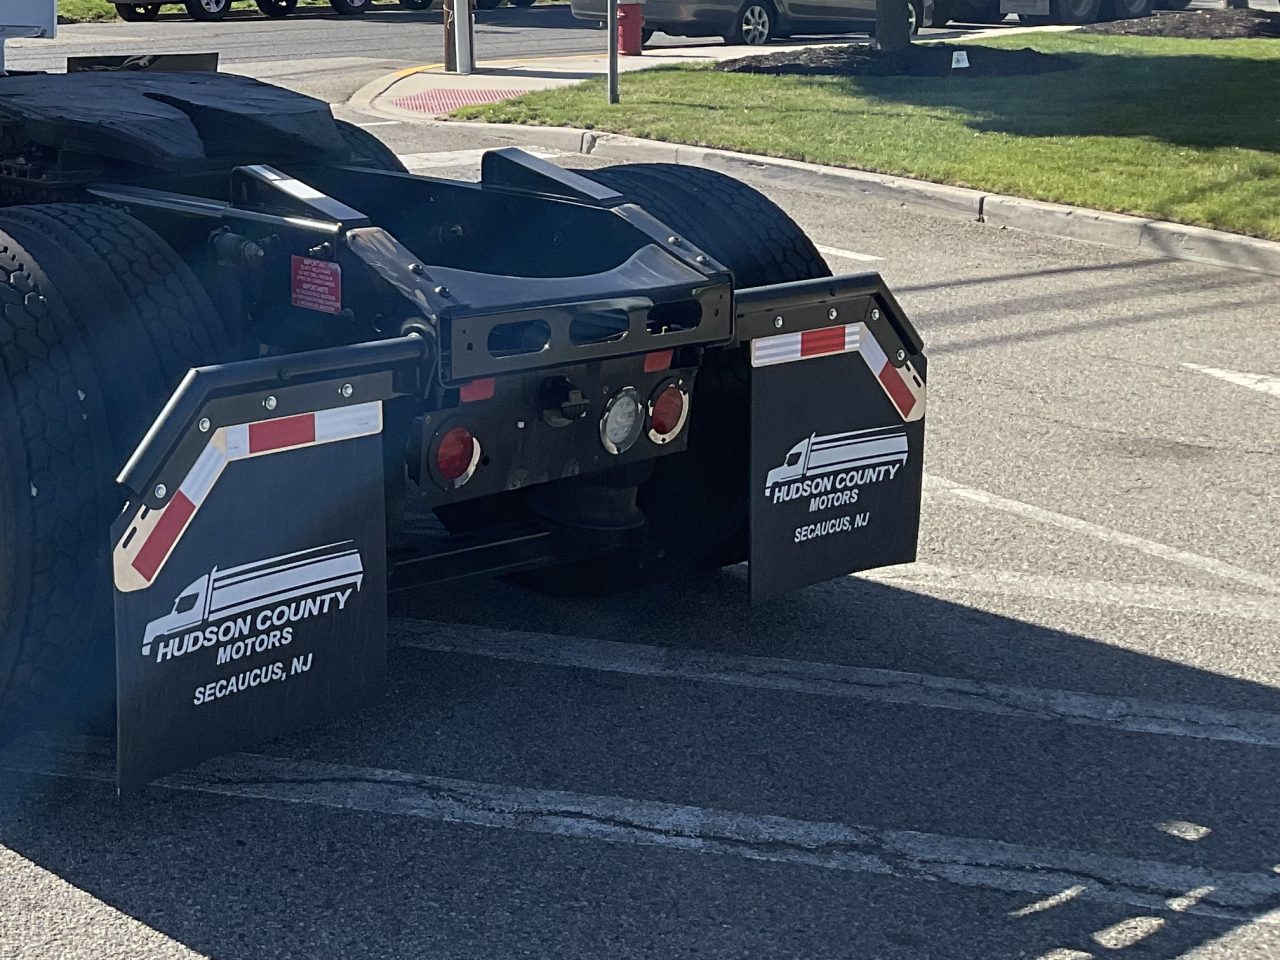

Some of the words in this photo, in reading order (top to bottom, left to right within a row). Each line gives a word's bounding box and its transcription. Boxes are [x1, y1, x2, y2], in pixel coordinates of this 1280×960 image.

[773, 475, 833, 504] HUDSON
[835, 464, 900, 489] COUNTY
[809, 489, 859, 512] MOTORS
[794, 517, 852, 543] SECAUCUS,
[854, 512, 870, 528] NJ
[156, 615, 251, 663] HUDSON
[256, 588, 352, 630] COUNTY
[216, 627, 293, 665] MOTORS
[193, 661, 287, 705] SECAUCUS,
[290, 653, 313, 675] NJ
